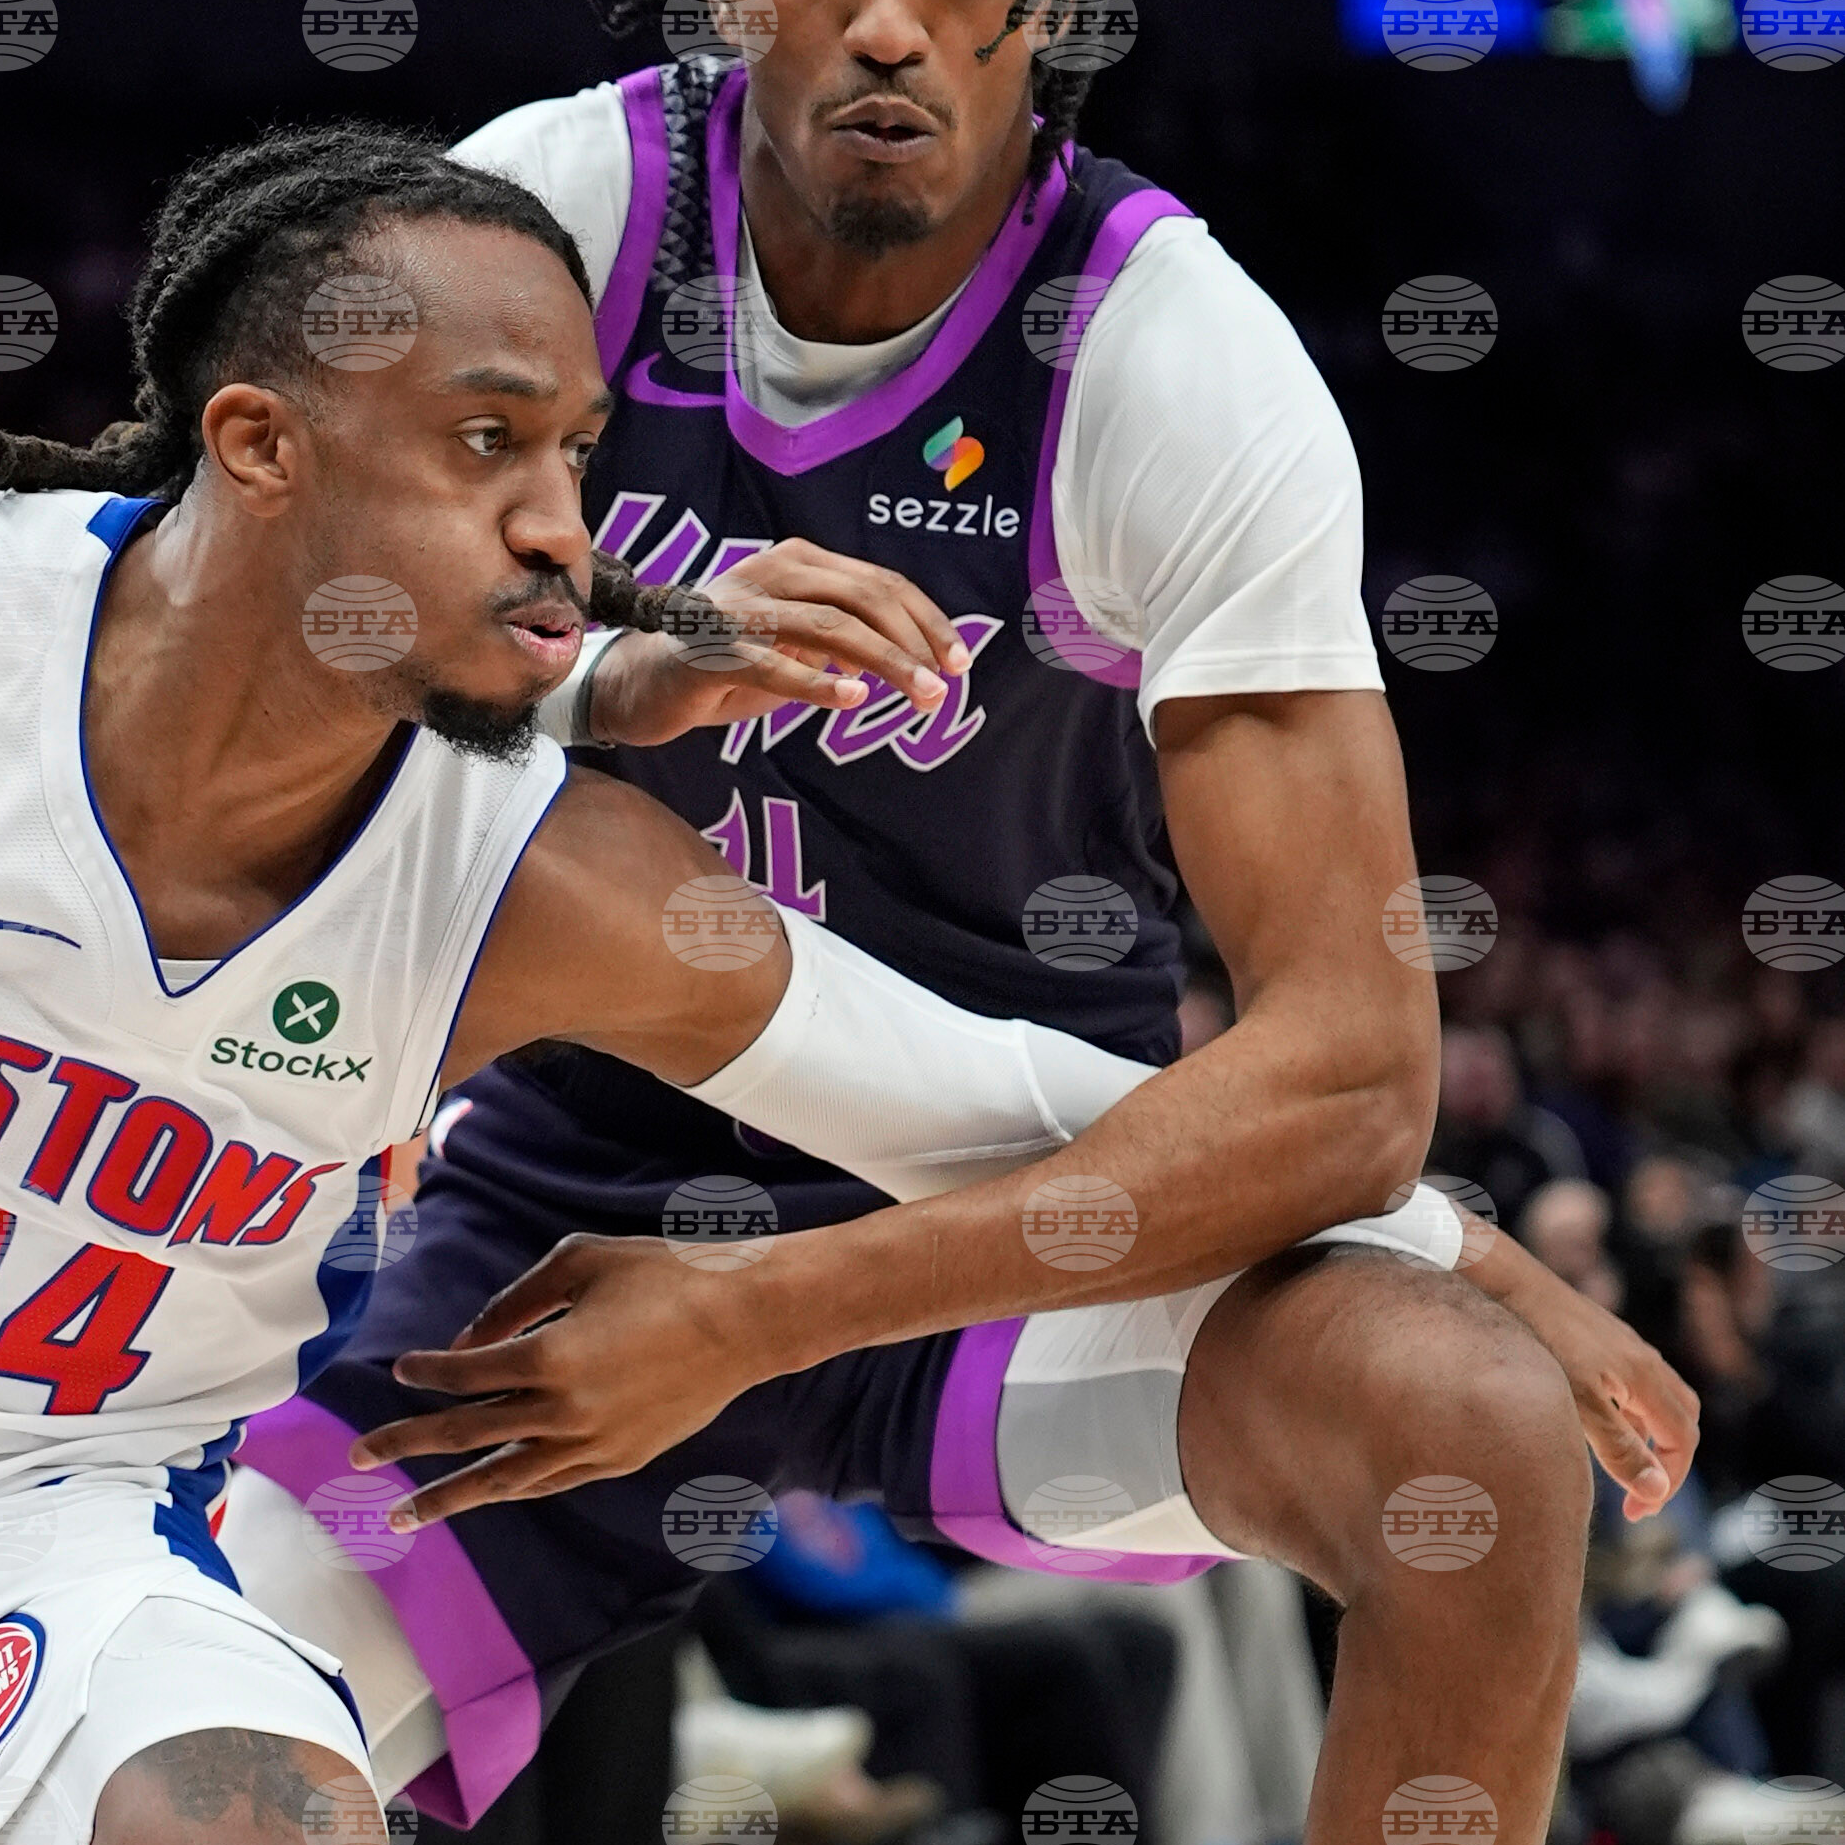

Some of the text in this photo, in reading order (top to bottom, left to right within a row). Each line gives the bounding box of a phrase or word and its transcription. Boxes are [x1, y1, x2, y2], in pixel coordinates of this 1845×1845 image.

[869, 493, 1021, 538] sezzle
[700, 787, 826, 922] 11
[210, 1037, 373, 1083] StockX
